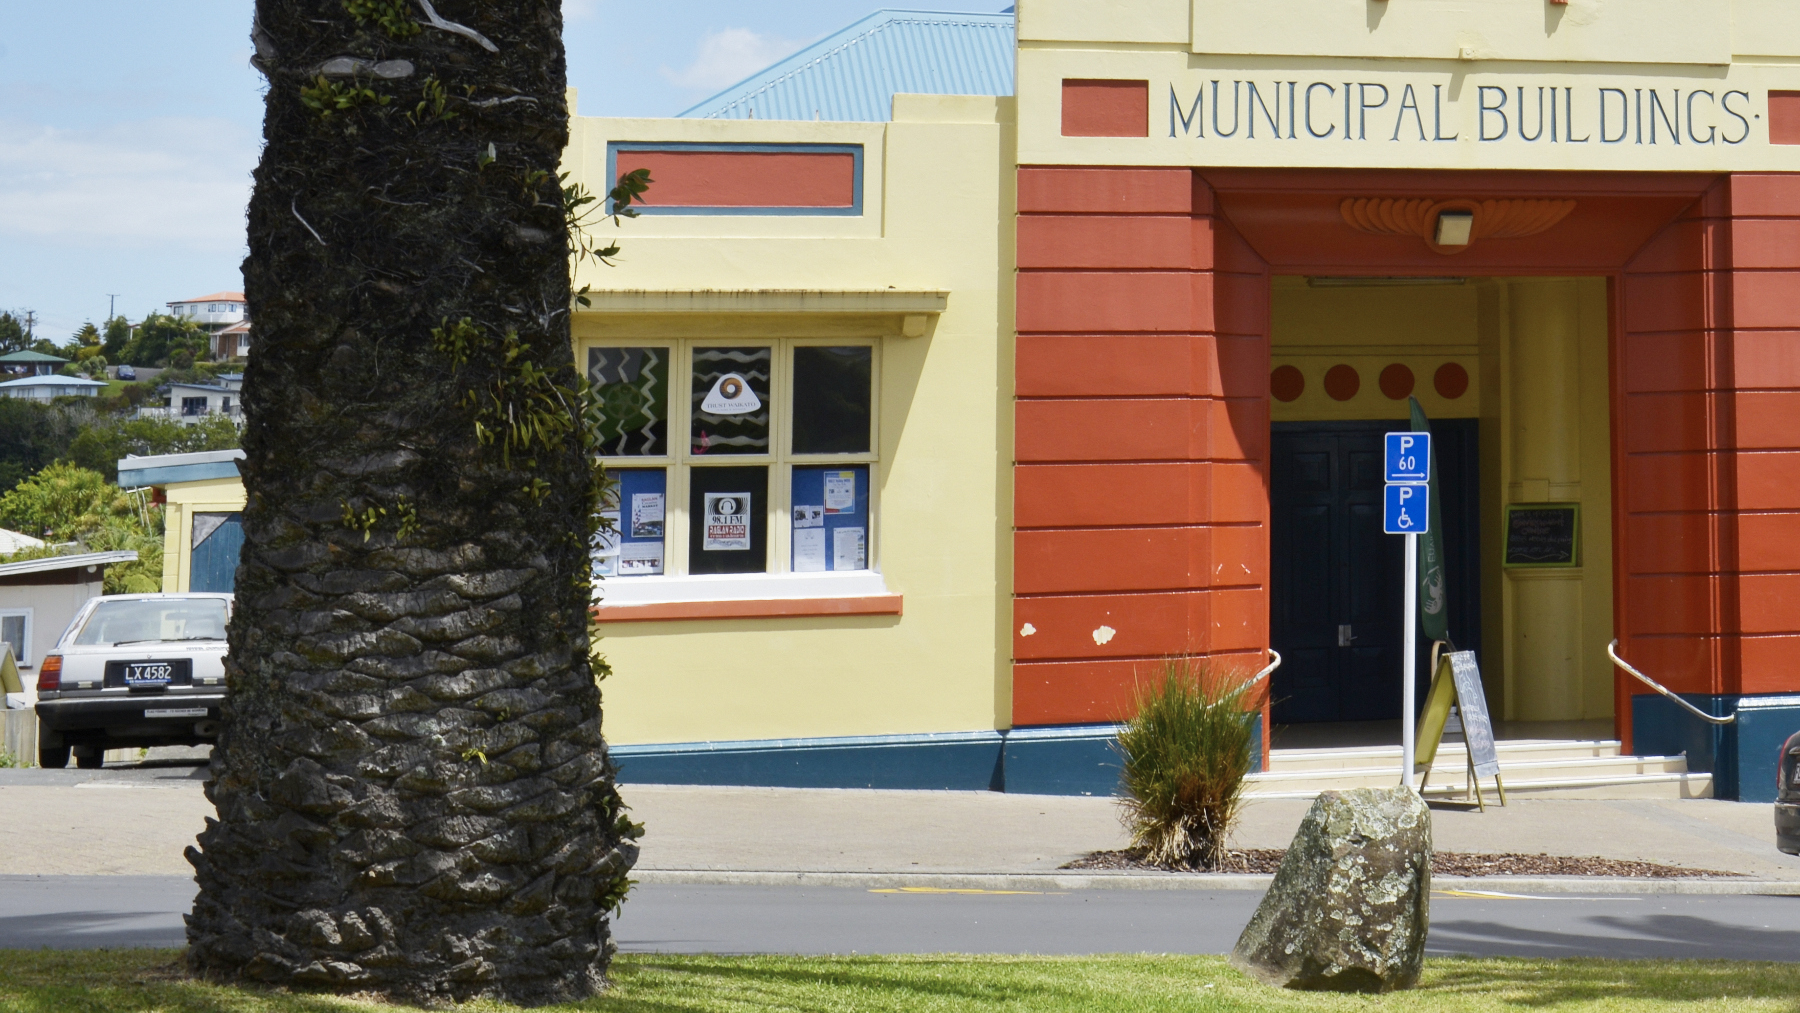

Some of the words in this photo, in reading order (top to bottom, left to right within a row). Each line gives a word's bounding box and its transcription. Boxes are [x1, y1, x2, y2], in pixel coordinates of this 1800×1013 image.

[1168, 80, 1459, 142] MUNICIPAL
[1401, 436, 1414, 455] P
[1399, 456, 1416, 471] 60
[1400, 487, 1413, 506] P
[712, 515, 727, 524] 98.1
[730, 515, 743, 524] FM
[125, 667, 142, 680] LX
[144, 666, 172, 679] 4582
